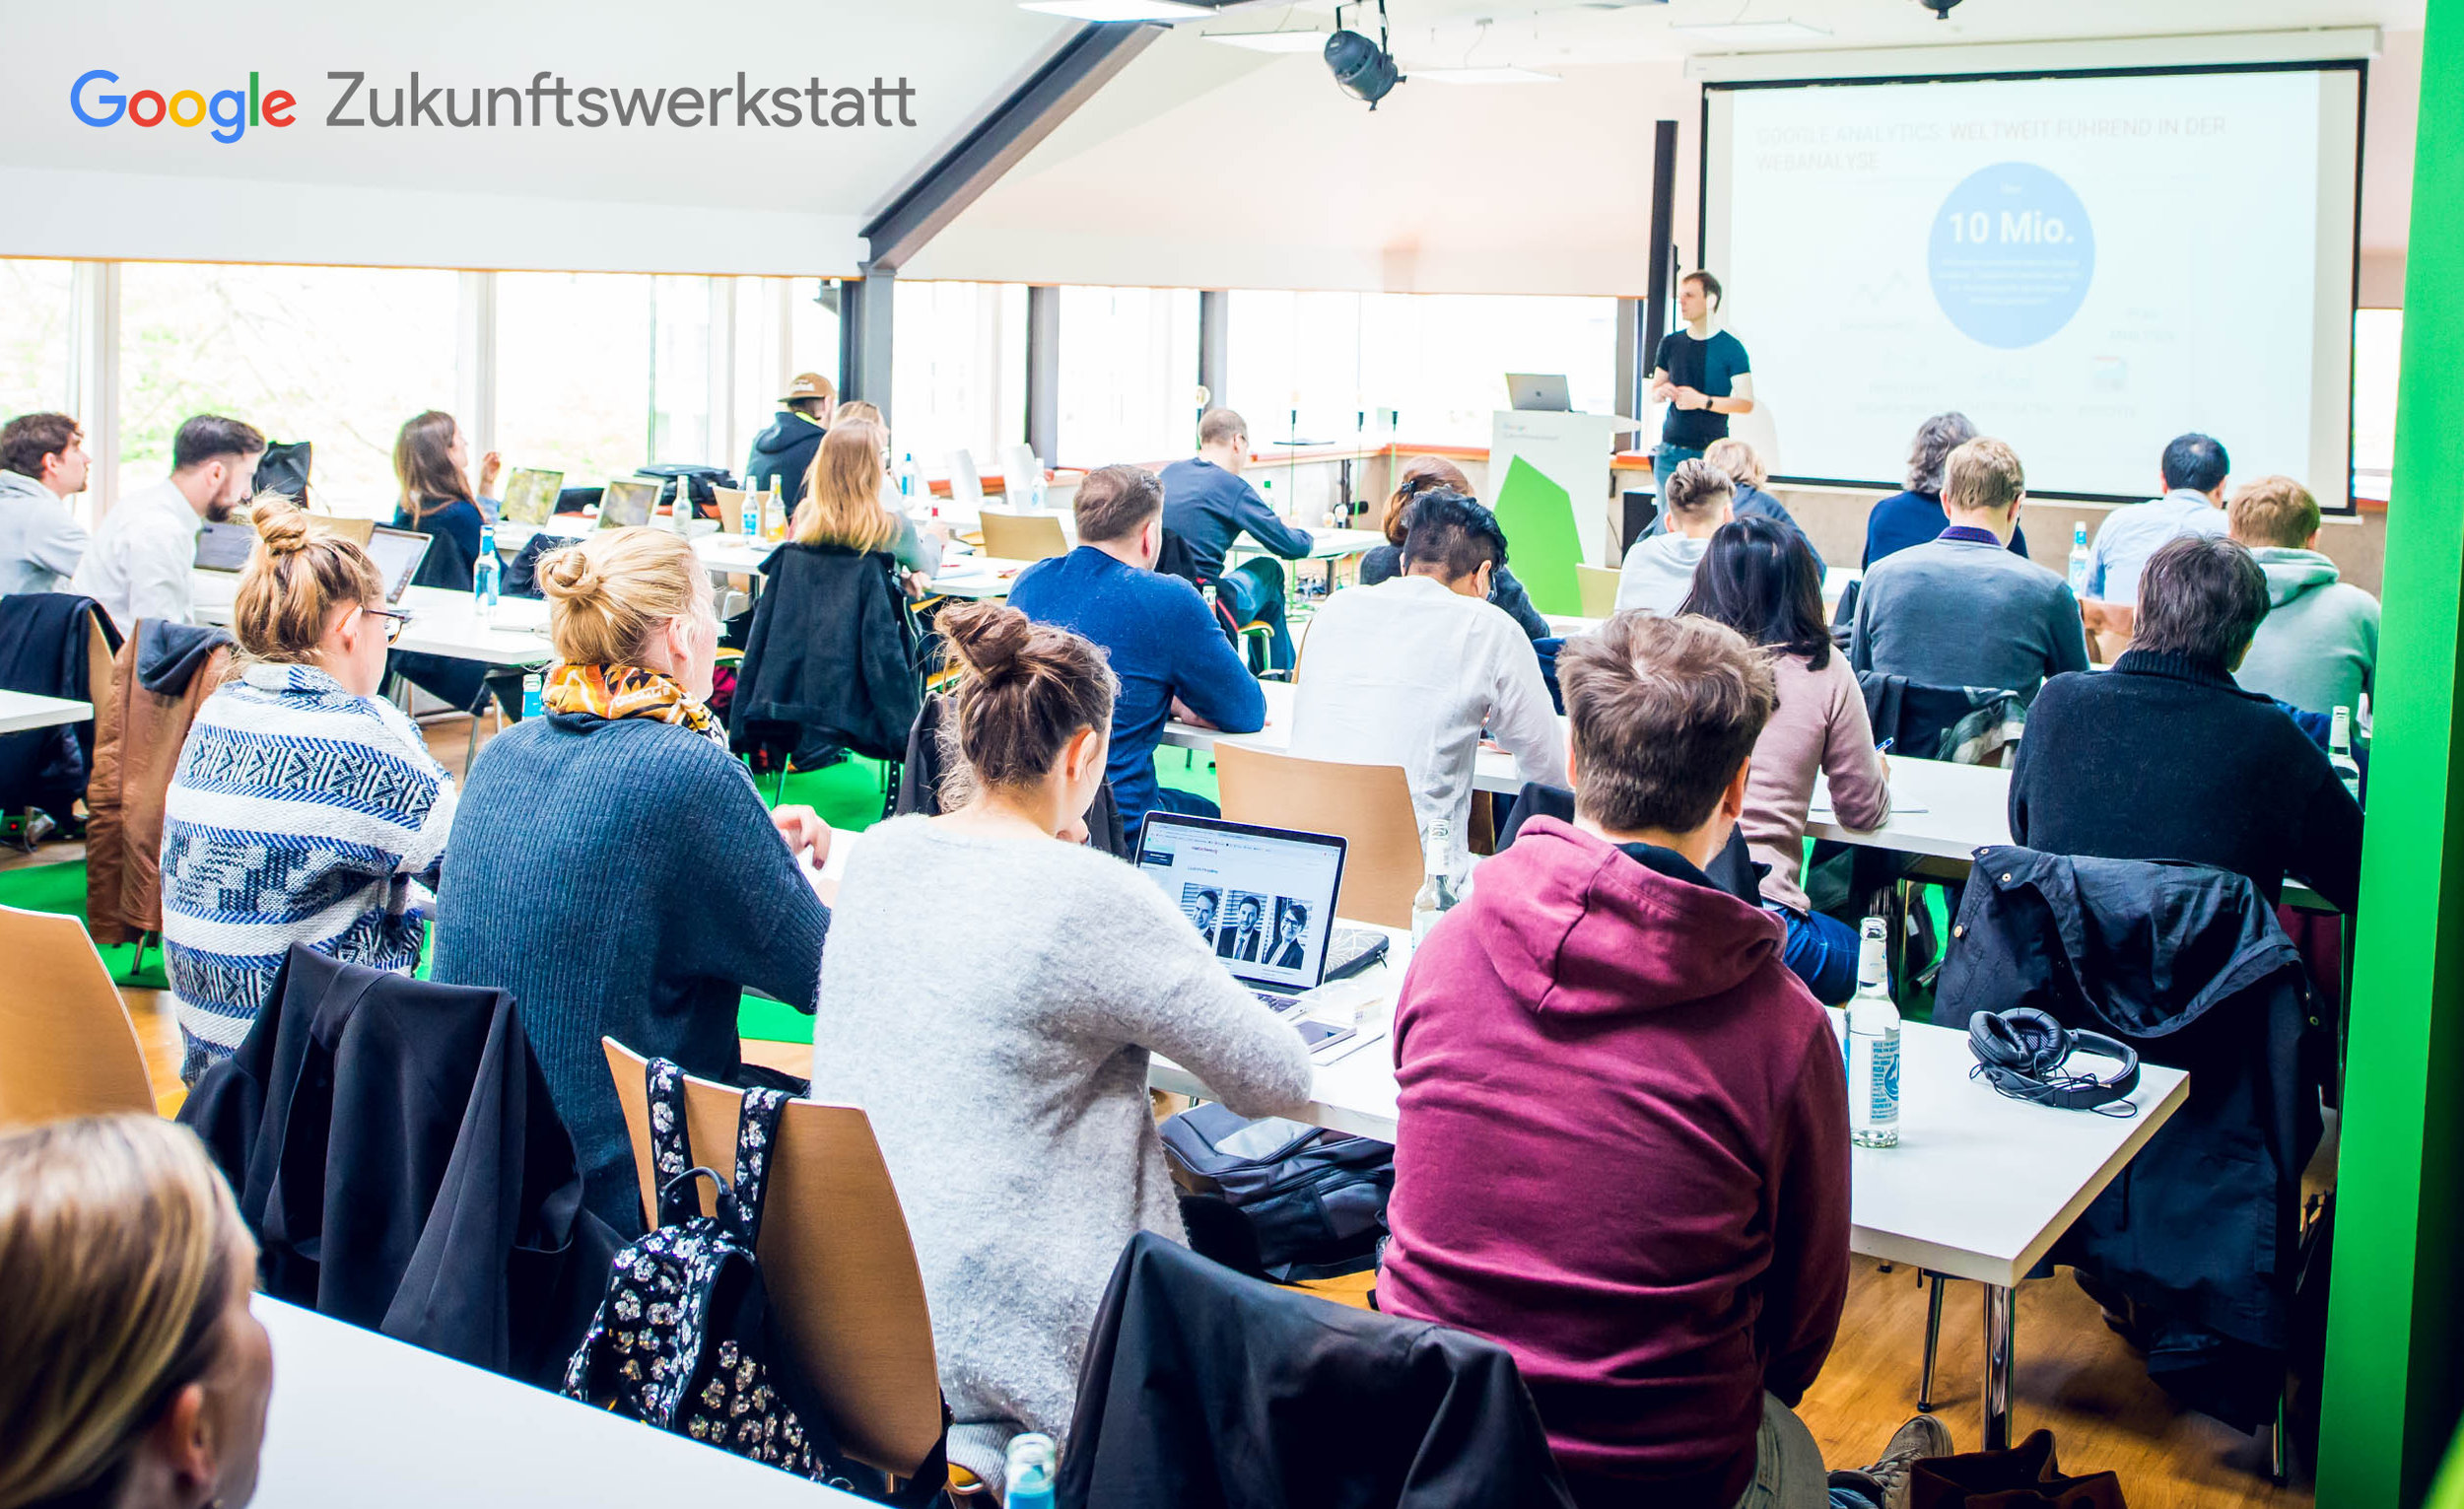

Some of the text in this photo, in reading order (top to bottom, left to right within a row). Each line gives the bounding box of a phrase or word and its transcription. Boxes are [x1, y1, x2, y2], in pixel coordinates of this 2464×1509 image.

[2158, 117, 2178, 136] IN
[2185, 114, 2226, 136] DER
[1950, 209, 2075, 244] 10 Mio.
